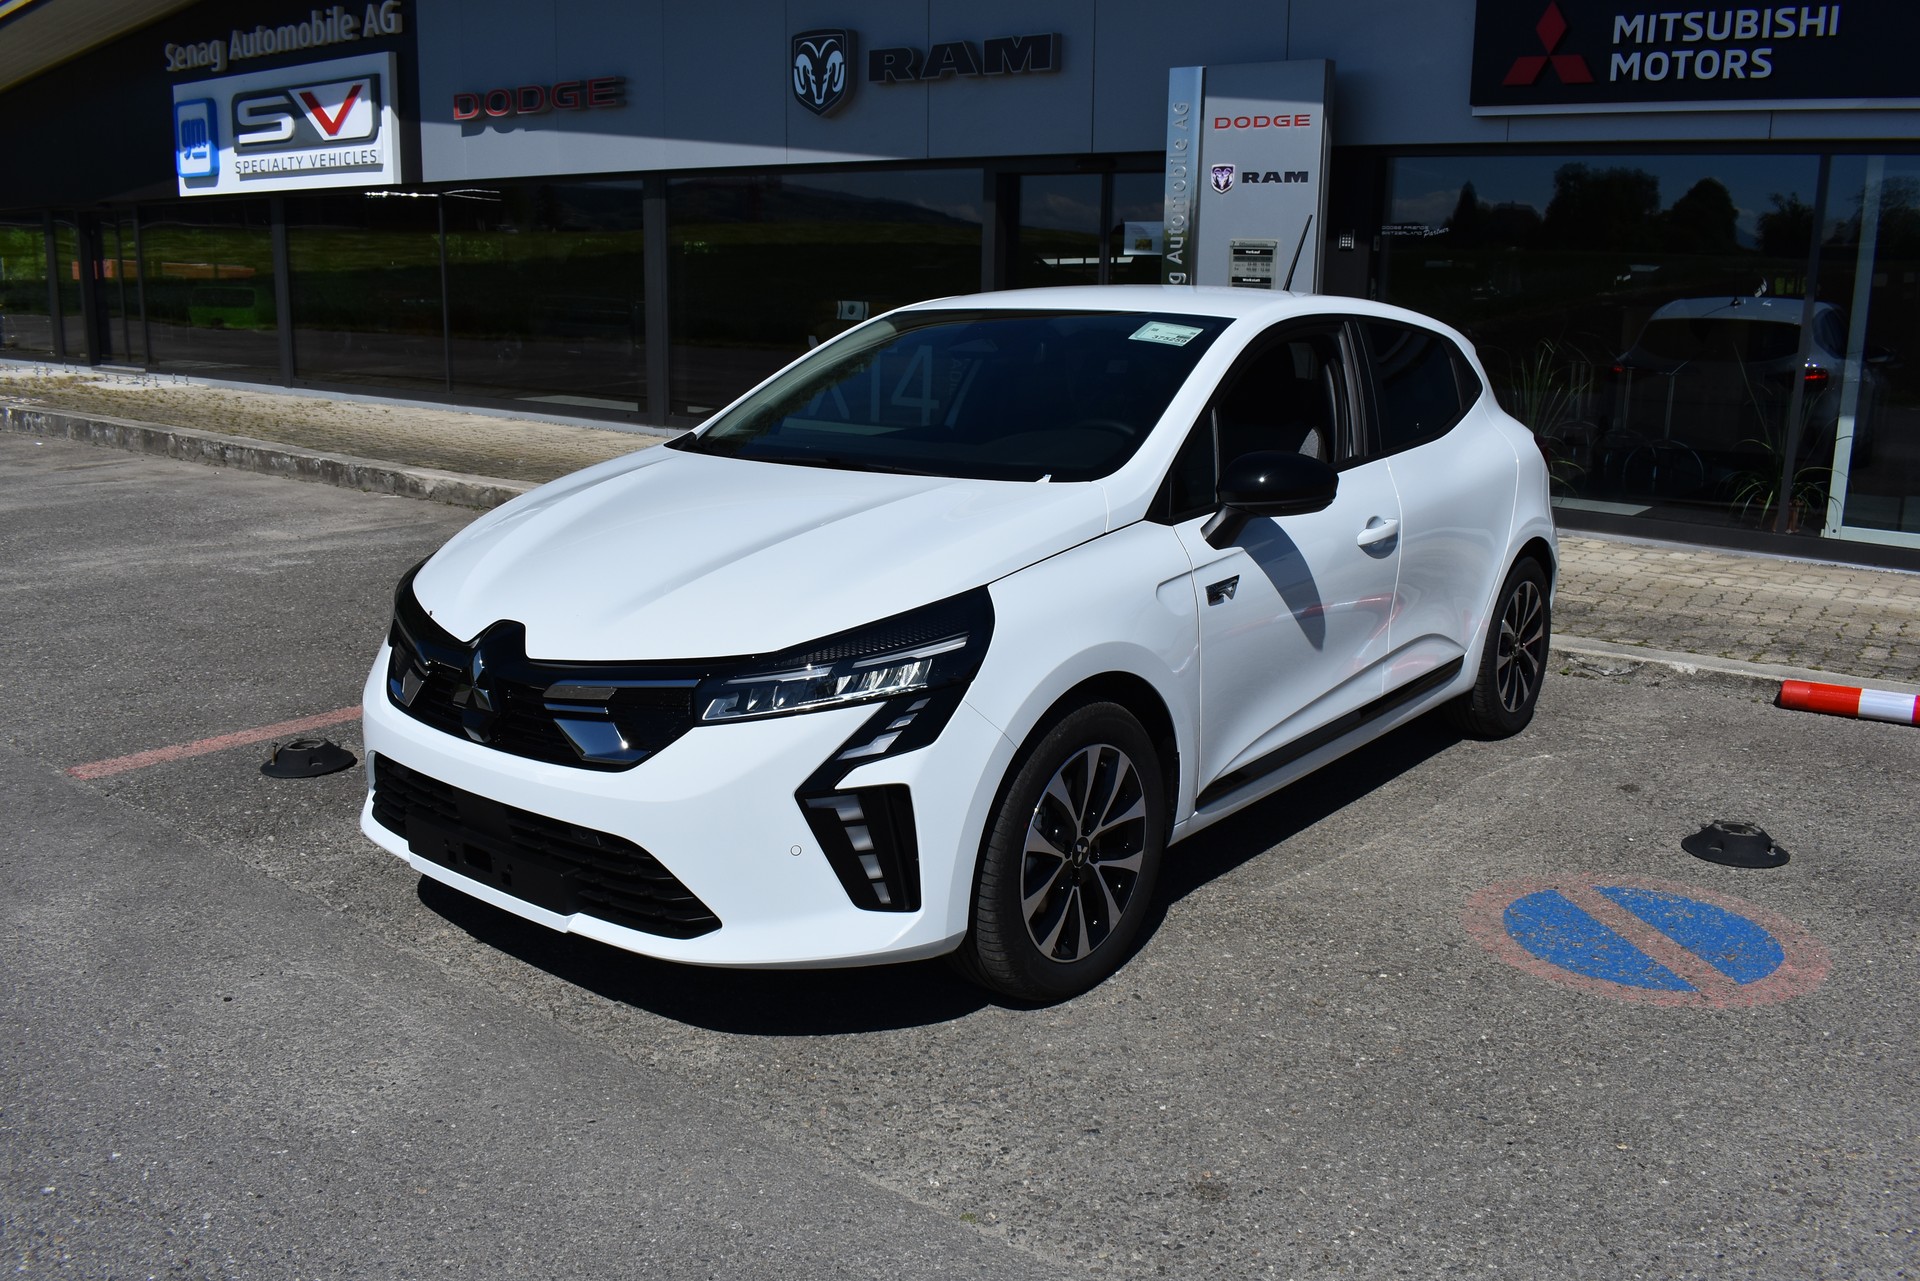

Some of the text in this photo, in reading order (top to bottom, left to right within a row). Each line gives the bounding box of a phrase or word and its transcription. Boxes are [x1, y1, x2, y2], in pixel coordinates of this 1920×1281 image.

[165, 0, 402, 72] Senag Automobile AG
[1613, 5, 1840, 45] MITSUBISHI
[868, 32, 1060, 83] RAM
[1609, 48, 1773, 82] MOTORS
[453, 76, 622, 121] DODGE
[1173, 102, 1190, 132] AG
[1214, 114, 1312, 130] DODGE
[235, 149, 378, 174] SPECIALTY VEHICLES
[1241, 171, 1309, 184] RAM
[1166, 139, 1188, 265] Automobile
